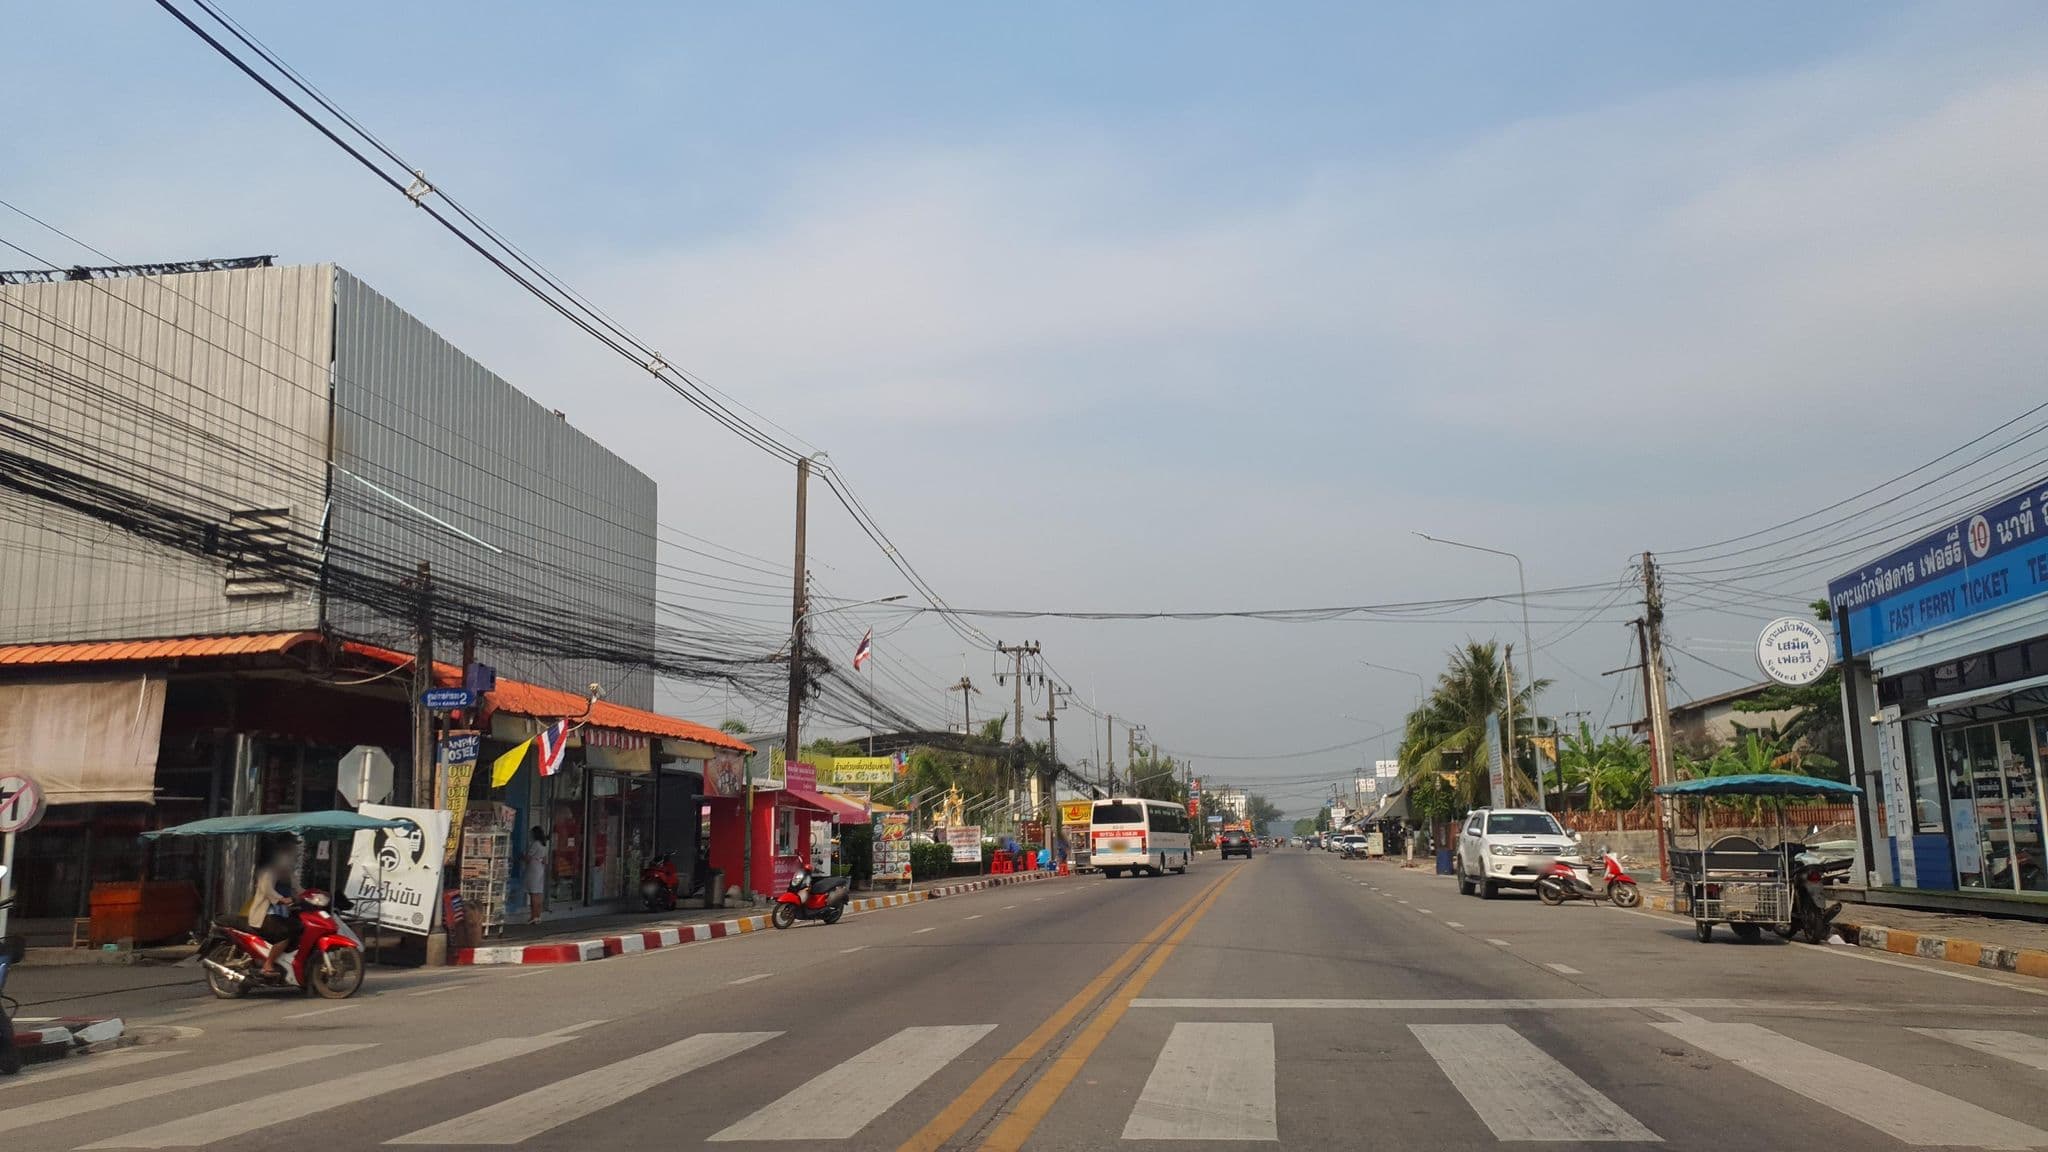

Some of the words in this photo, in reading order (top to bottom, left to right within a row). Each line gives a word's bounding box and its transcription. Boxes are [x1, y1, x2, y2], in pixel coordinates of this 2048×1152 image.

[1833, 561, 1915, 612] เกาะแก้วพิสดาร
[1971, 521, 1988, 552] 10
[1997, 497, 2035, 545] นาที
[1889, 602, 1915, 633] FAST
[1920, 587, 1957, 622] FERRY
[1961, 568, 2009, 608] TICKET
[460, 692, 468, 705] 2
[1766, 659, 1797, 681] Samed
[1802, 658, 1826, 680] Ferry
[1887, 714, 1906, 838] TICKET
